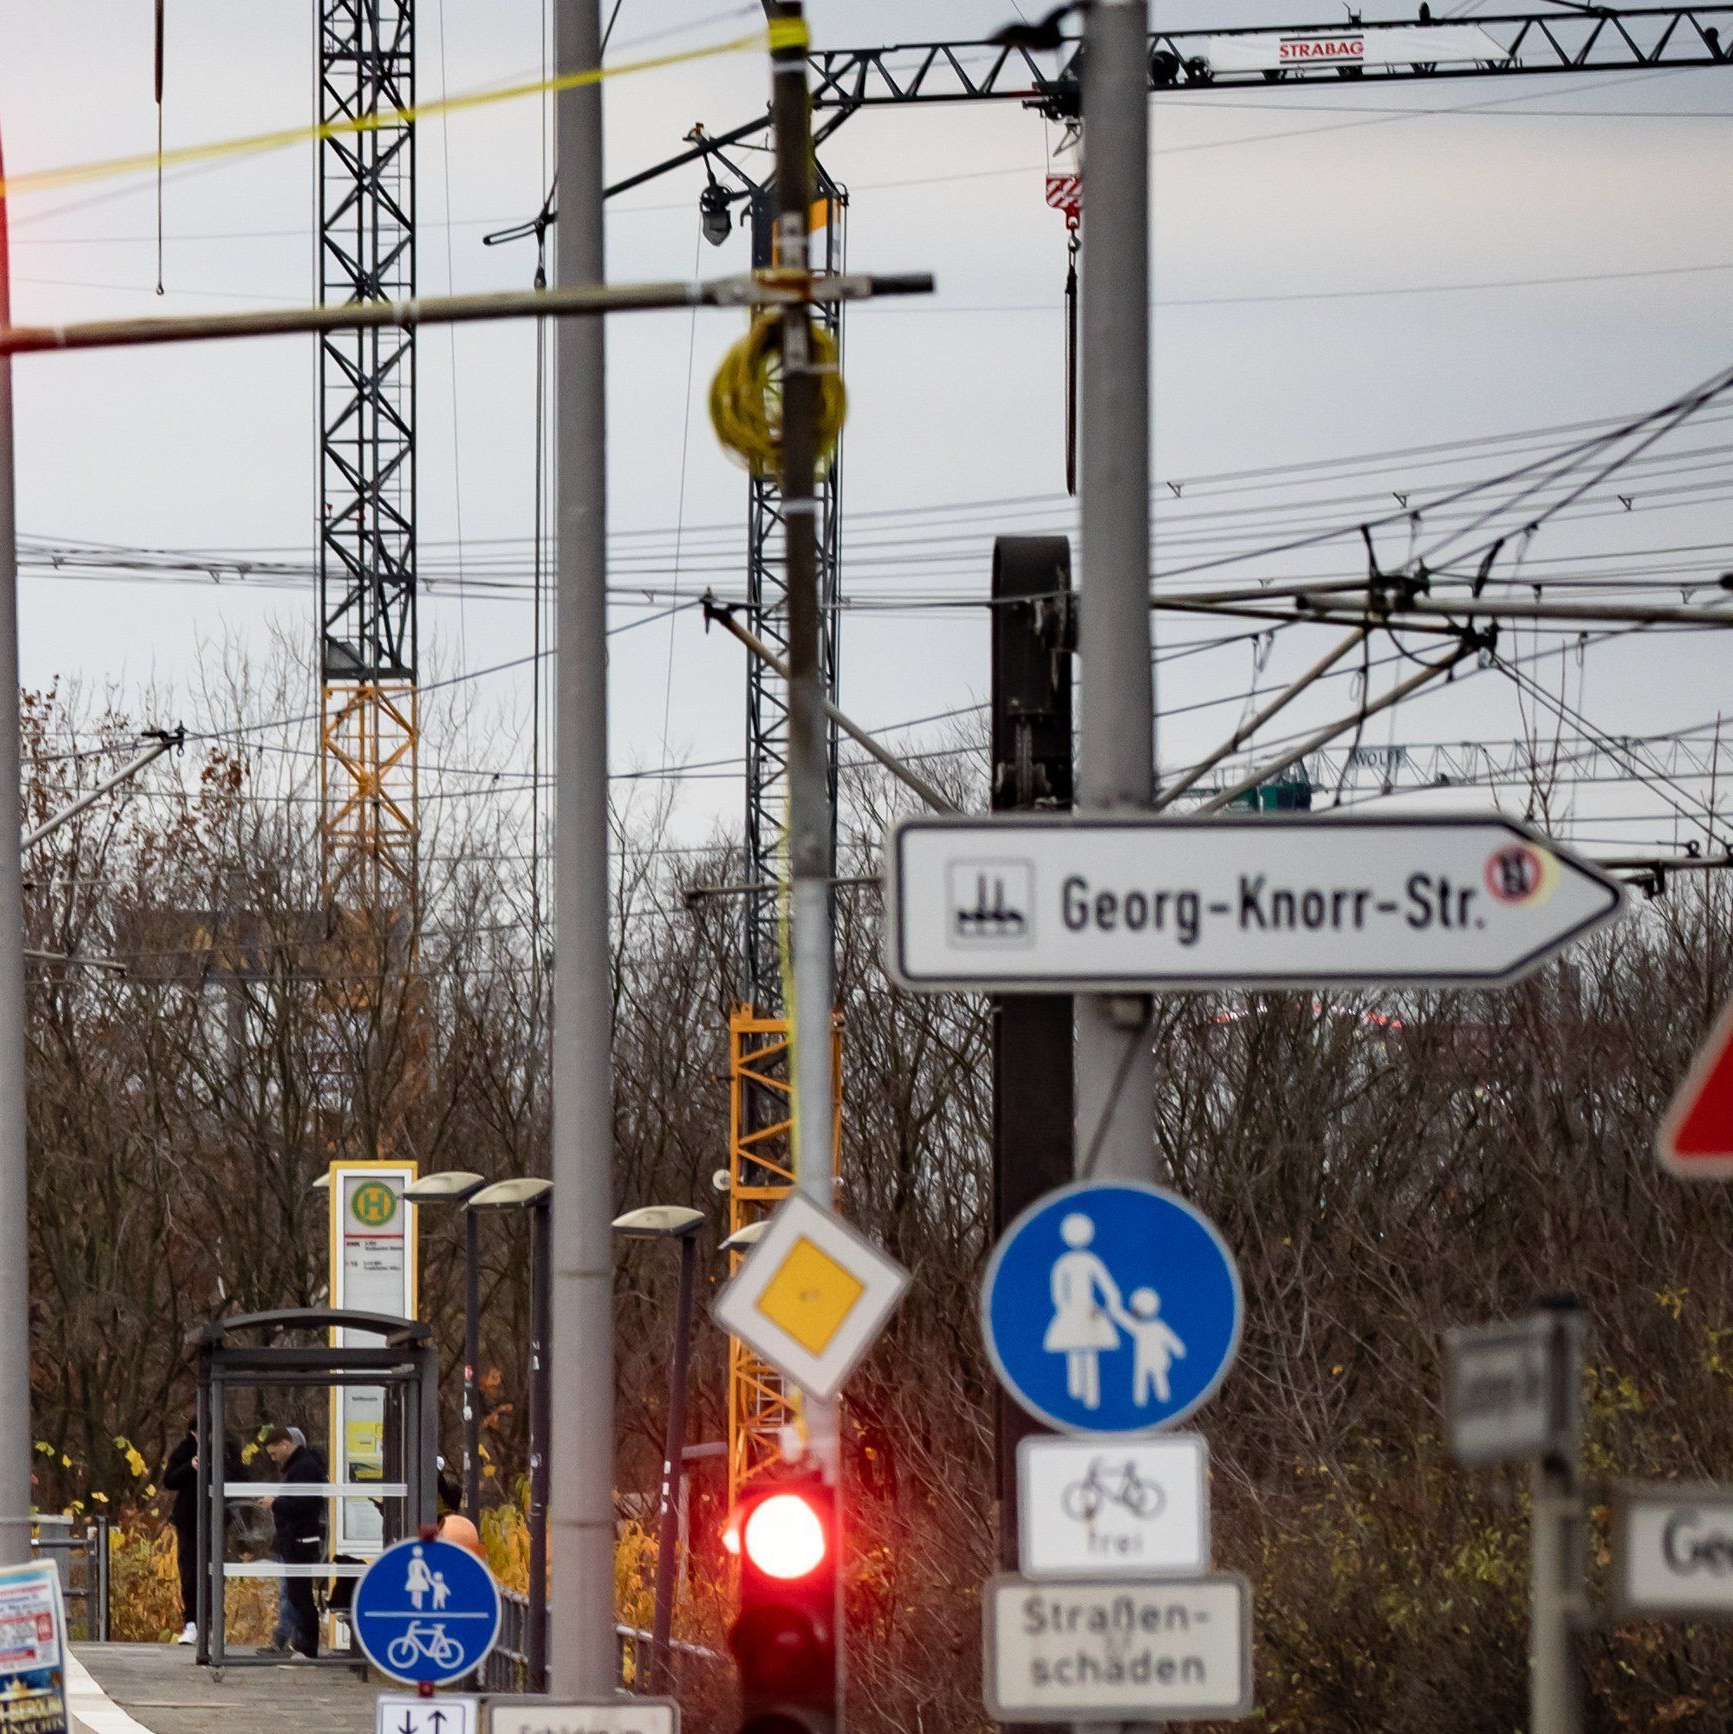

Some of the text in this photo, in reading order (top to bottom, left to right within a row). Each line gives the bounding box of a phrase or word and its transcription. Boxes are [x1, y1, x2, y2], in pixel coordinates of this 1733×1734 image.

[1279, 41, 1364, 58] STRABAG
[1060, 871, 1488, 946] Georg-Knorr-Str.
[1086, 1528, 1144, 1557] frei
[1023, 1594, 1212, 1637] Straßen-
